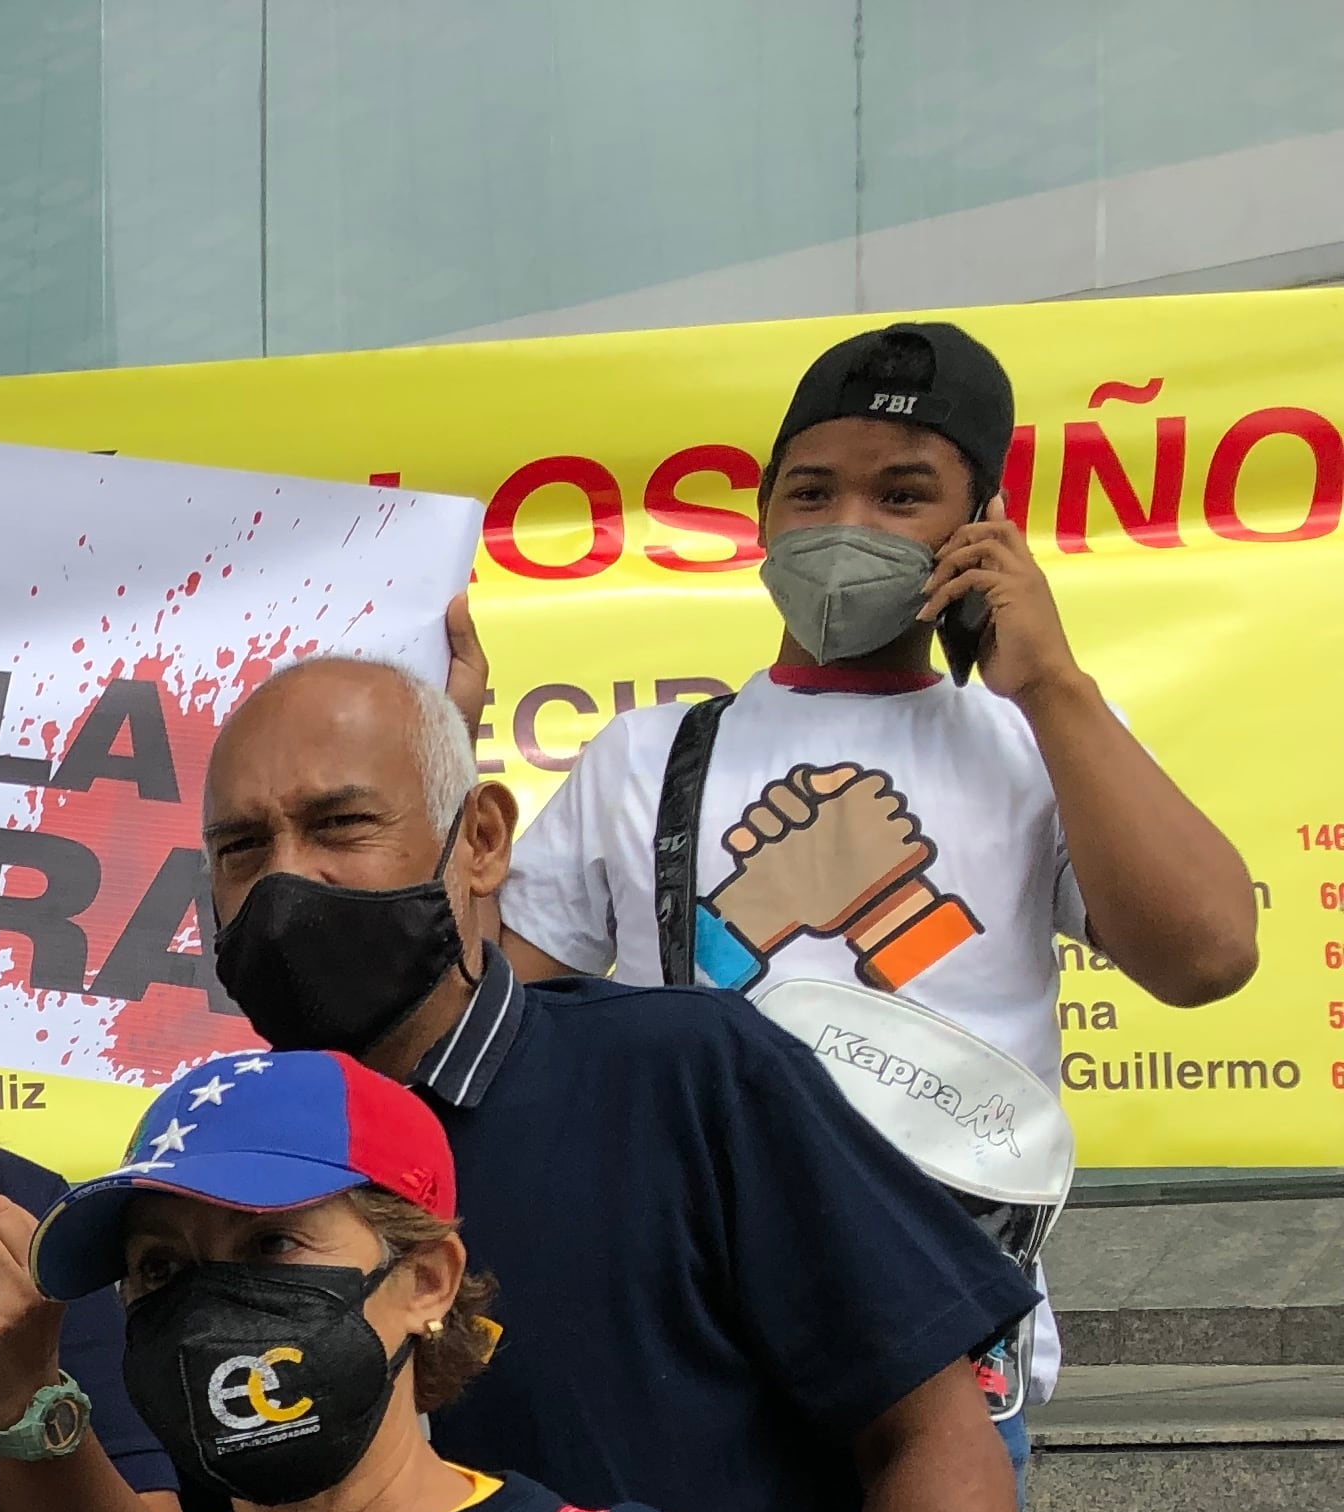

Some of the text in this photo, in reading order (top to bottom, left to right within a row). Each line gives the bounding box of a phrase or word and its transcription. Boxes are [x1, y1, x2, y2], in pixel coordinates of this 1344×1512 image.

[868, 392, 918, 415] FBI
[369, 445, 768, 584] OS
[813, 1024, 962, 1117] Kappa
[1061, 1051, 1301, 1091] Guillermo
